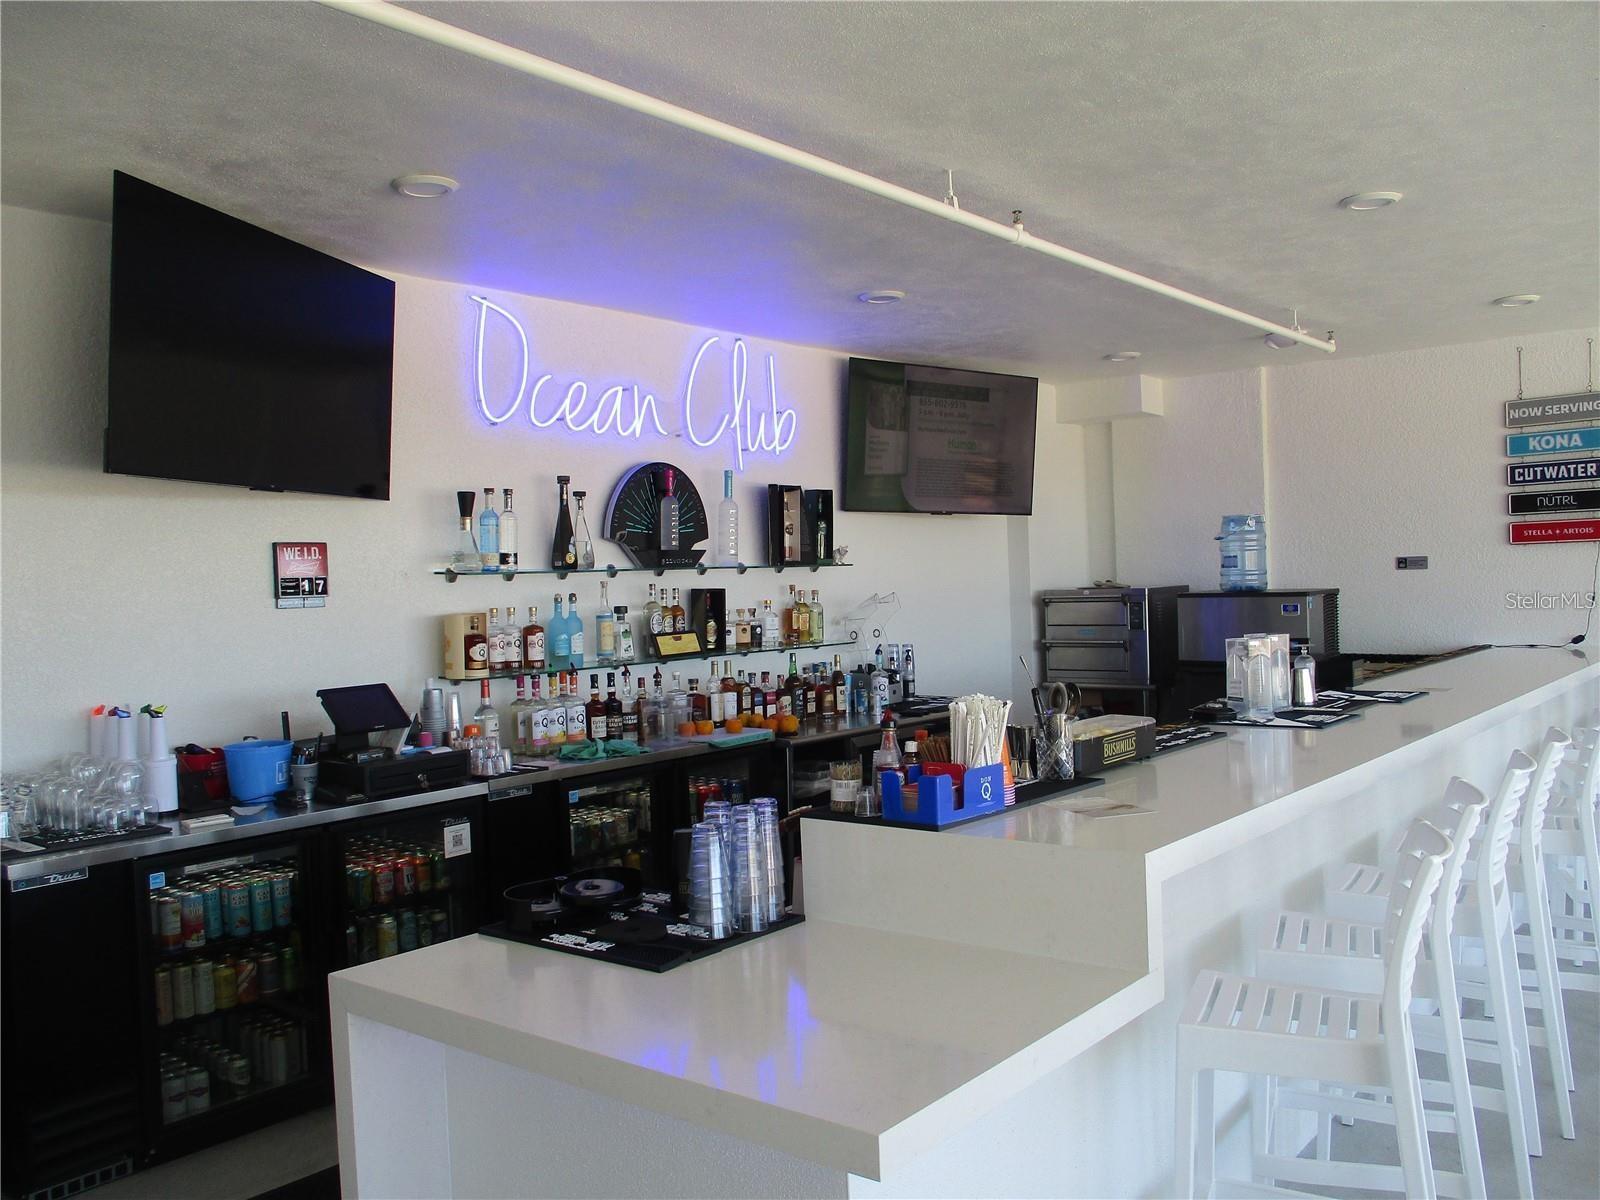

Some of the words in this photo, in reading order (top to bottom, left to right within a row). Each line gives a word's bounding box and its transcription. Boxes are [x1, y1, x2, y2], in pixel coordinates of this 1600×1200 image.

[469, 295, 668, 438] Ocean
[686, 336, 797, 471] Club
[1509, 406, 1543, 419] NOW
[1544, 400, 1600, 416] SERVING
[1528, 433, 1583, 451] KONA
[1514, 462, 1597, 481] CUTWATER
[1523, 529, 1553, 537] STELLA
[1562, 527, 1595, 535] ARTOIS
[283, 546, 302, 560] WE
[303, 546, 322, 560] I.D.
[981, 782, 993, 801] Q
[44, 871, 84, 882] True
